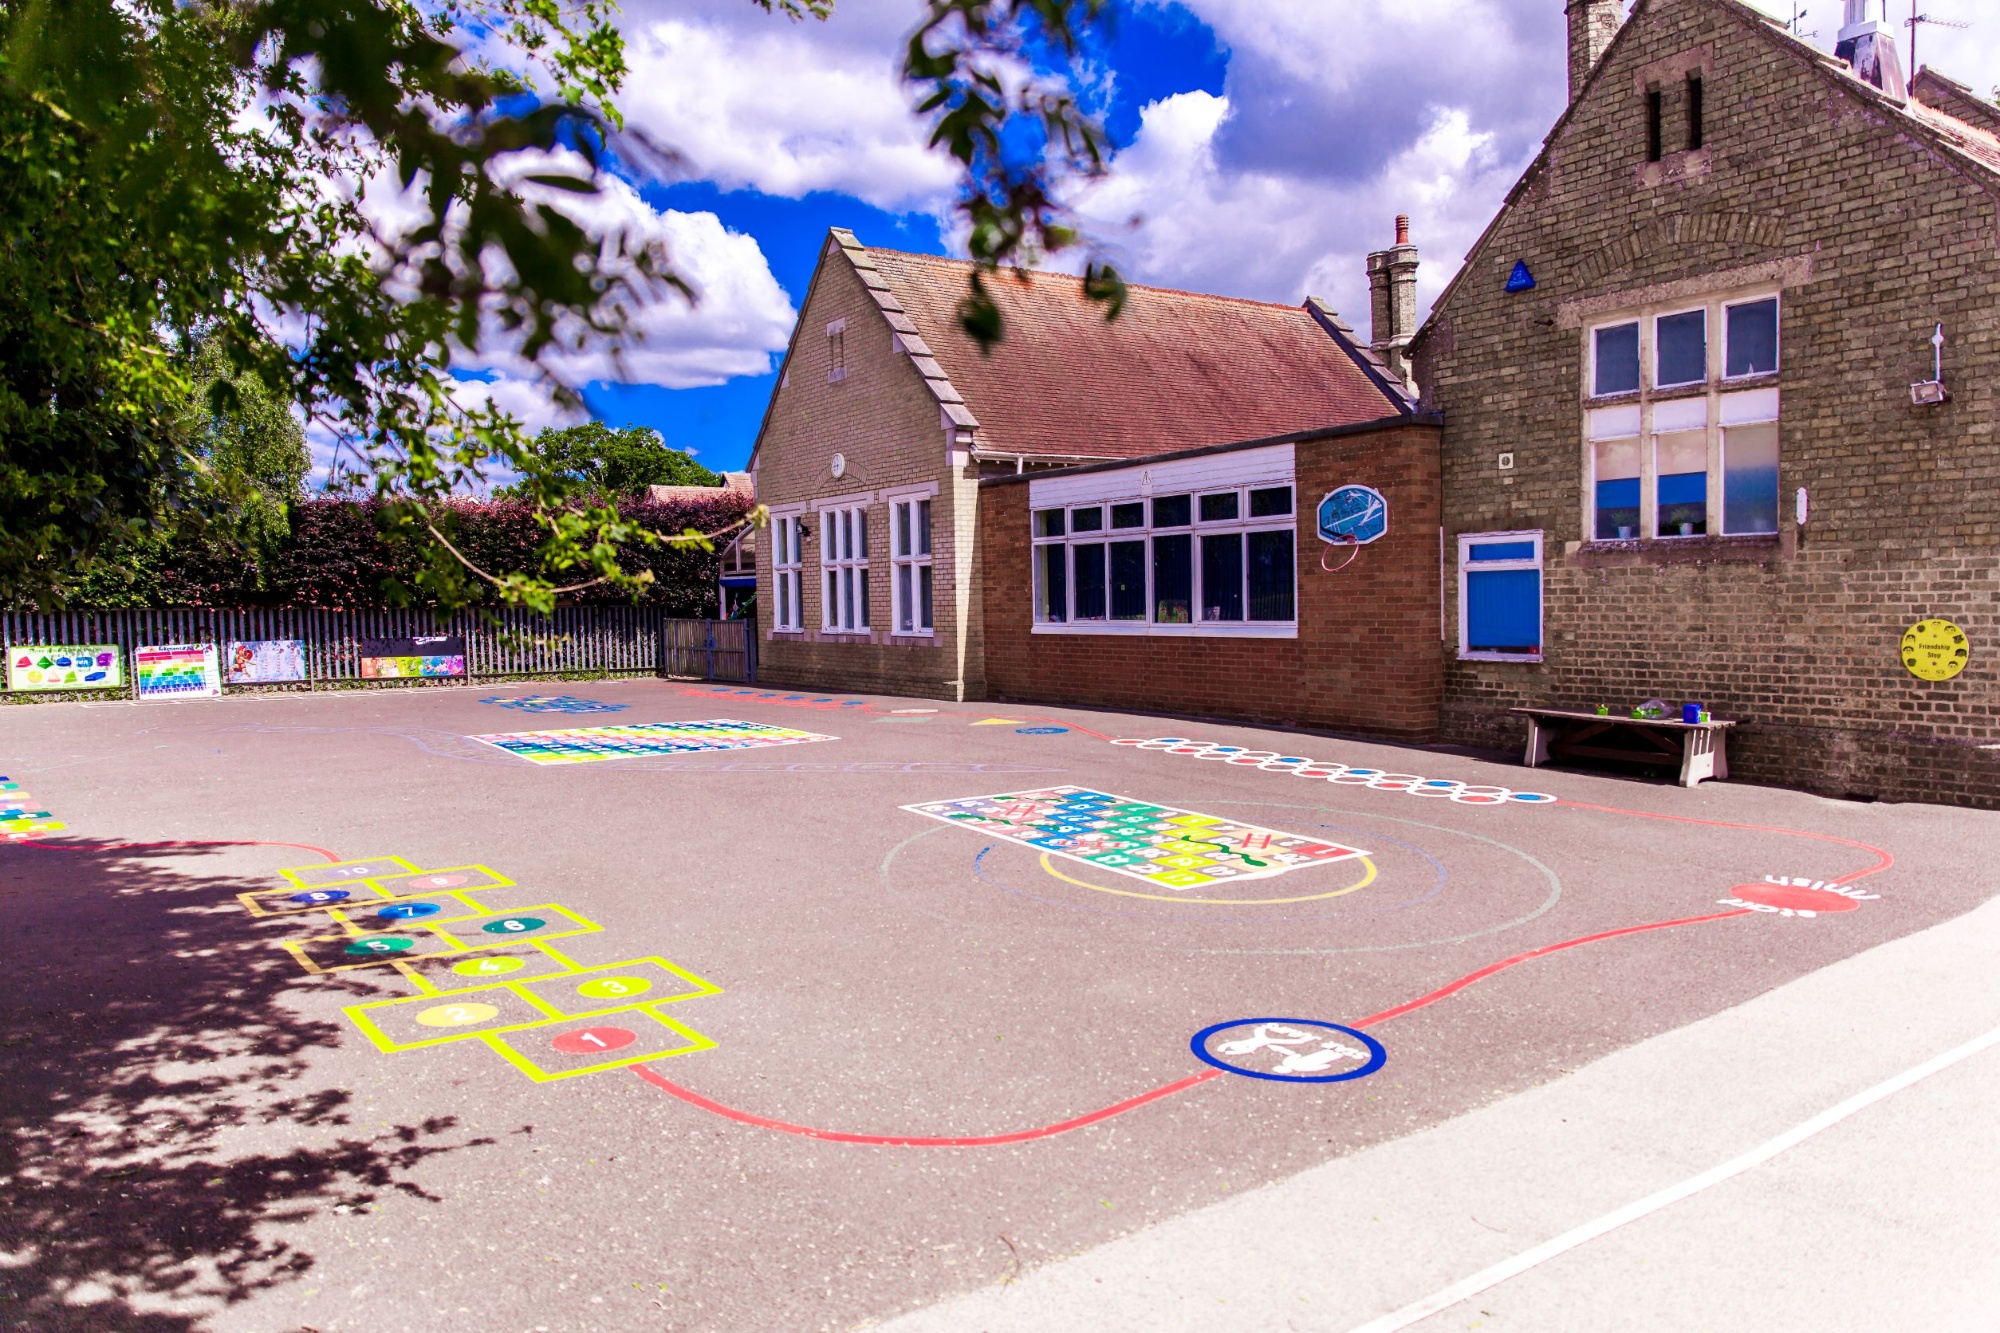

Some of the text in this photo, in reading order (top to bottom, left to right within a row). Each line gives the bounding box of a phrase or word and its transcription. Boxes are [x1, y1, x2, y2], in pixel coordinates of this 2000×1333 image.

[1919, 643, 1950, 651] Friendship
[337, 866, 369, 876] 10
[430, 877, 449, 885] 9
[310, 892, 331, 901] 8
[398, 906, 414, 917] 7
[503, 920, 525, 931] 6
[366, 941, 392, 951] 5
[479, 960, 500, 972] 4
[601, 980, 628, 993] 3
[445, 1007, 475, 1022] 2
[580, 1032, 607, 1047] 1
